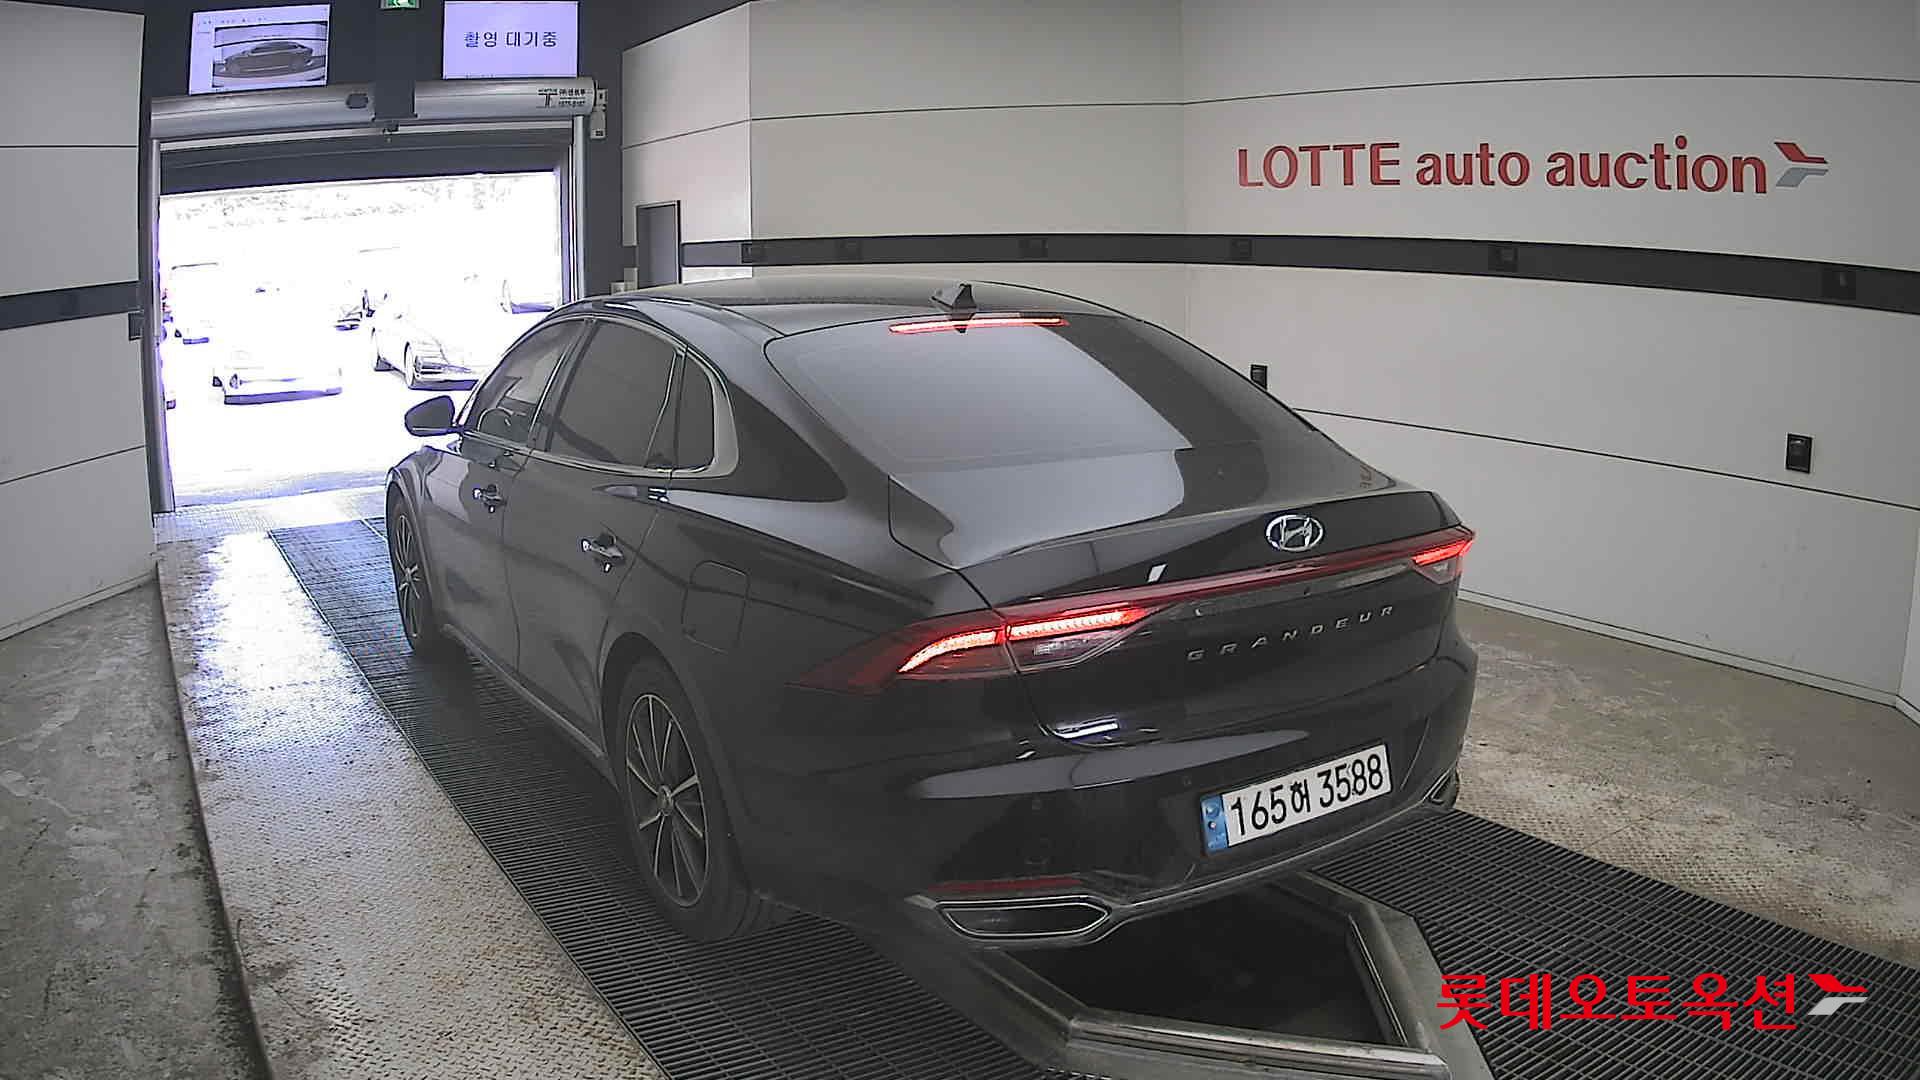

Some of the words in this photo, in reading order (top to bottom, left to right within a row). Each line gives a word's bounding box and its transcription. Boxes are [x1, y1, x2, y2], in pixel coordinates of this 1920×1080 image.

[1238, 142, 1401, 188] LOTTE
[1416, 143, 1530, 187] auto
[1546, 135, 1767, 194] auction
[1187, 605, 1393, 661] GRANDEUR
[1317, 754, 1383, 808] 3588
